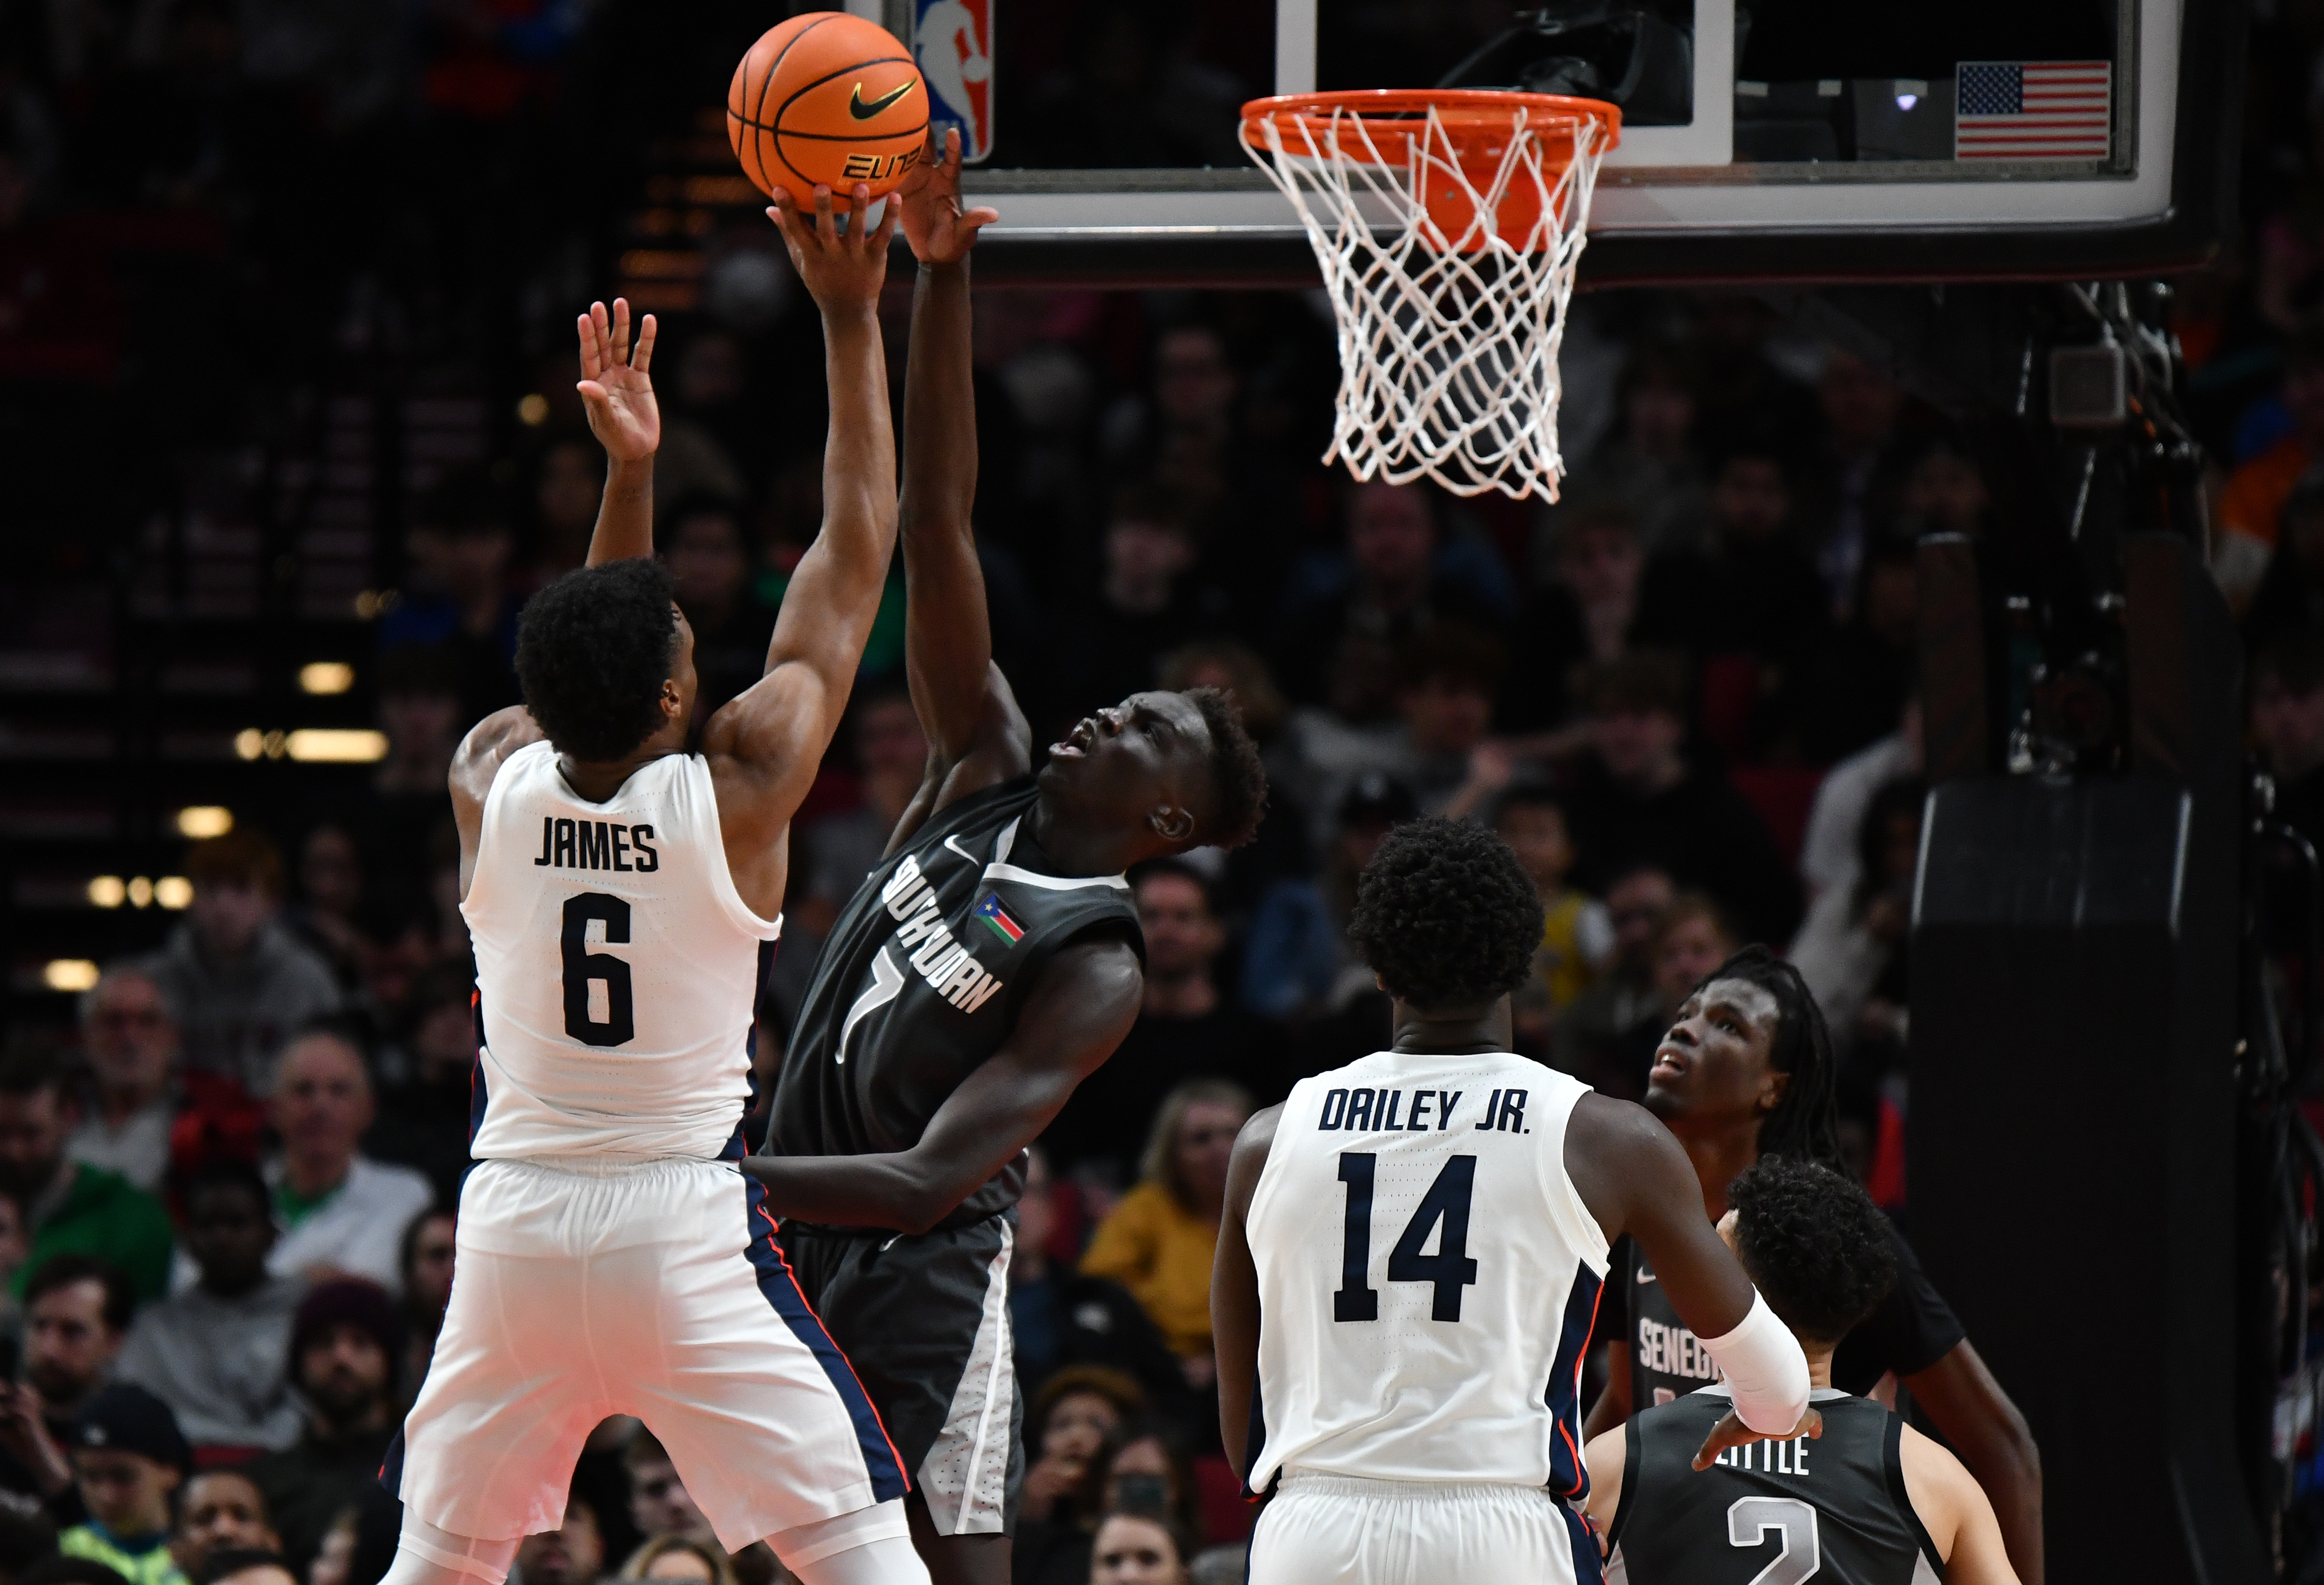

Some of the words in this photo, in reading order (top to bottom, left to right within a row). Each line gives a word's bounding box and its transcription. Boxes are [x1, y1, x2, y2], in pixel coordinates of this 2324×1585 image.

[842, 143, 924, 179] ELITE
[534, 817, 658, 872] JAMES
[561, 892, 634, 1047] 6
[834, 945, 905, 1065] 7
[909, 924, 1003, 1015] SUDAN
[1318, 1089, 1463, 1131] DAILEY
[1475, 1089, 1530, 1134] JR.
[1334, 1152, 1477, 1322] 14
[1727, 1495, 1821, 1585] 2
